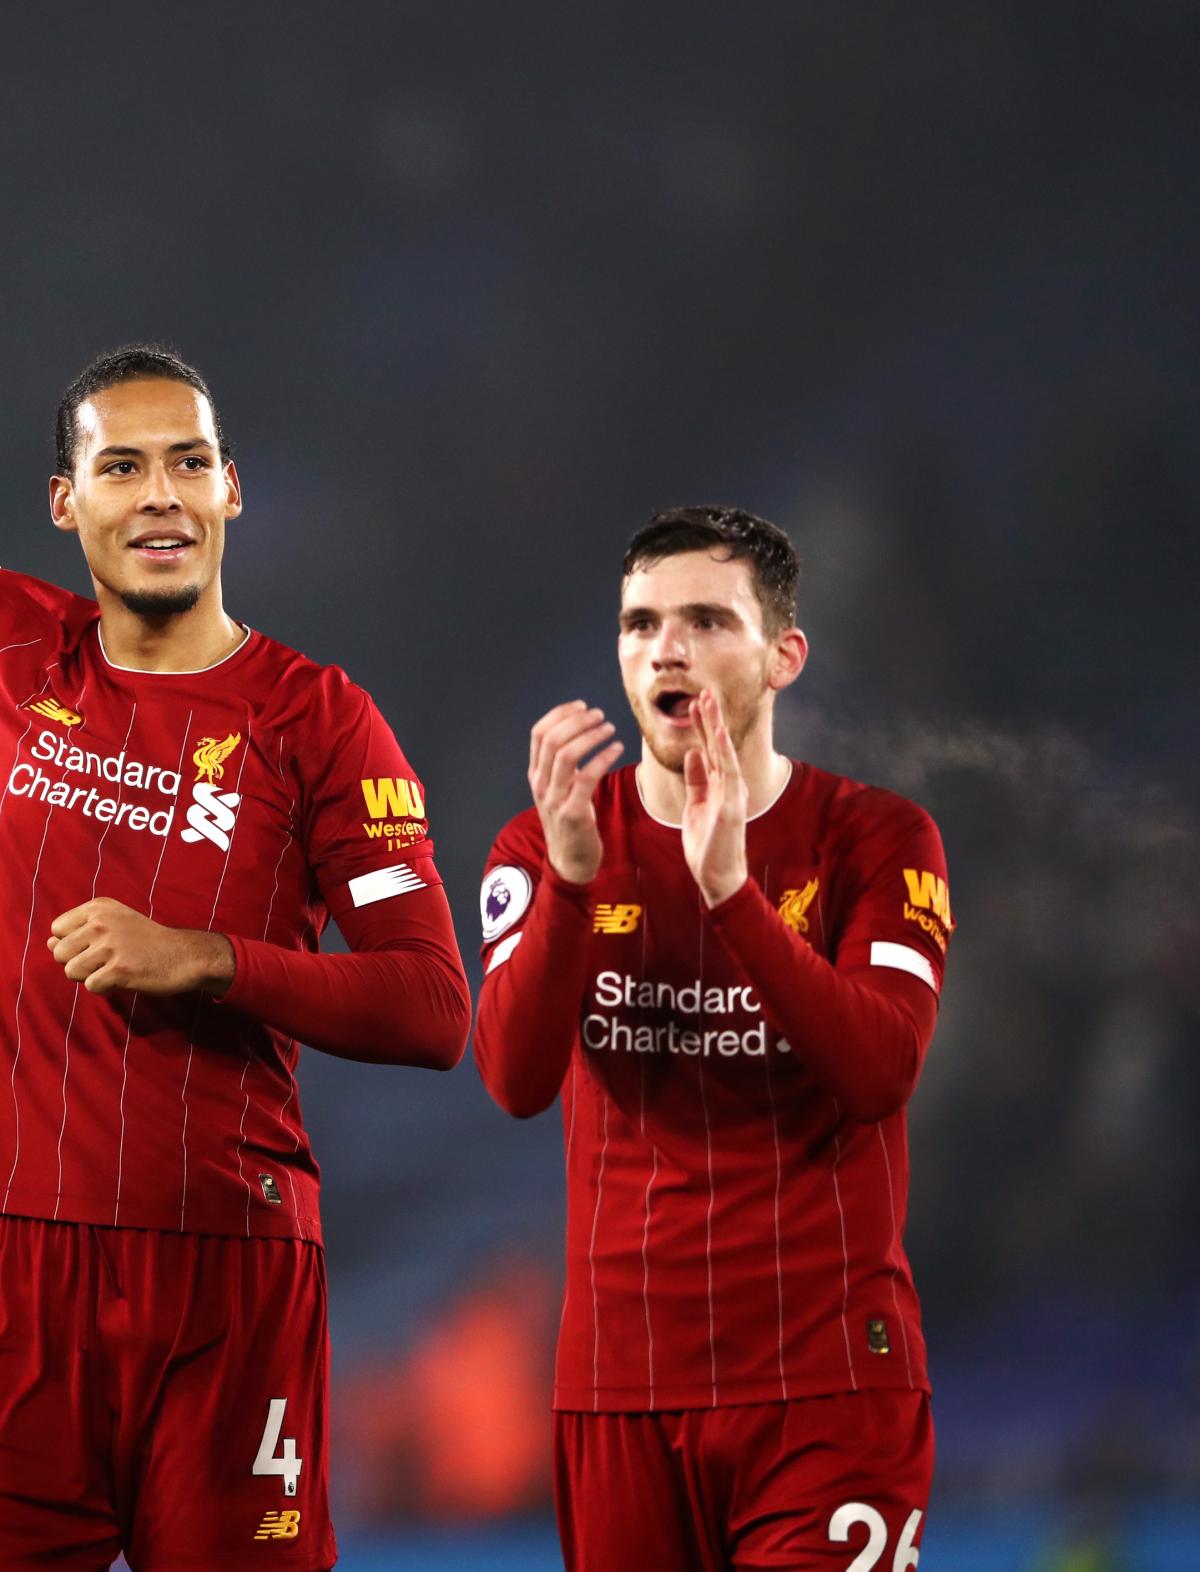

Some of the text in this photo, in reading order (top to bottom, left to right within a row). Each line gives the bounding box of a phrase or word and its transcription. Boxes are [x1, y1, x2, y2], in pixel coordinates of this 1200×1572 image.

[8, 763, 176, 837] Chartered
[361, 777, 425, 820] WU
[362, 820, 427, 839] Western
[582, 1013, 767, 1057] Chartered
[252, 1398, 302, 1497] 4
